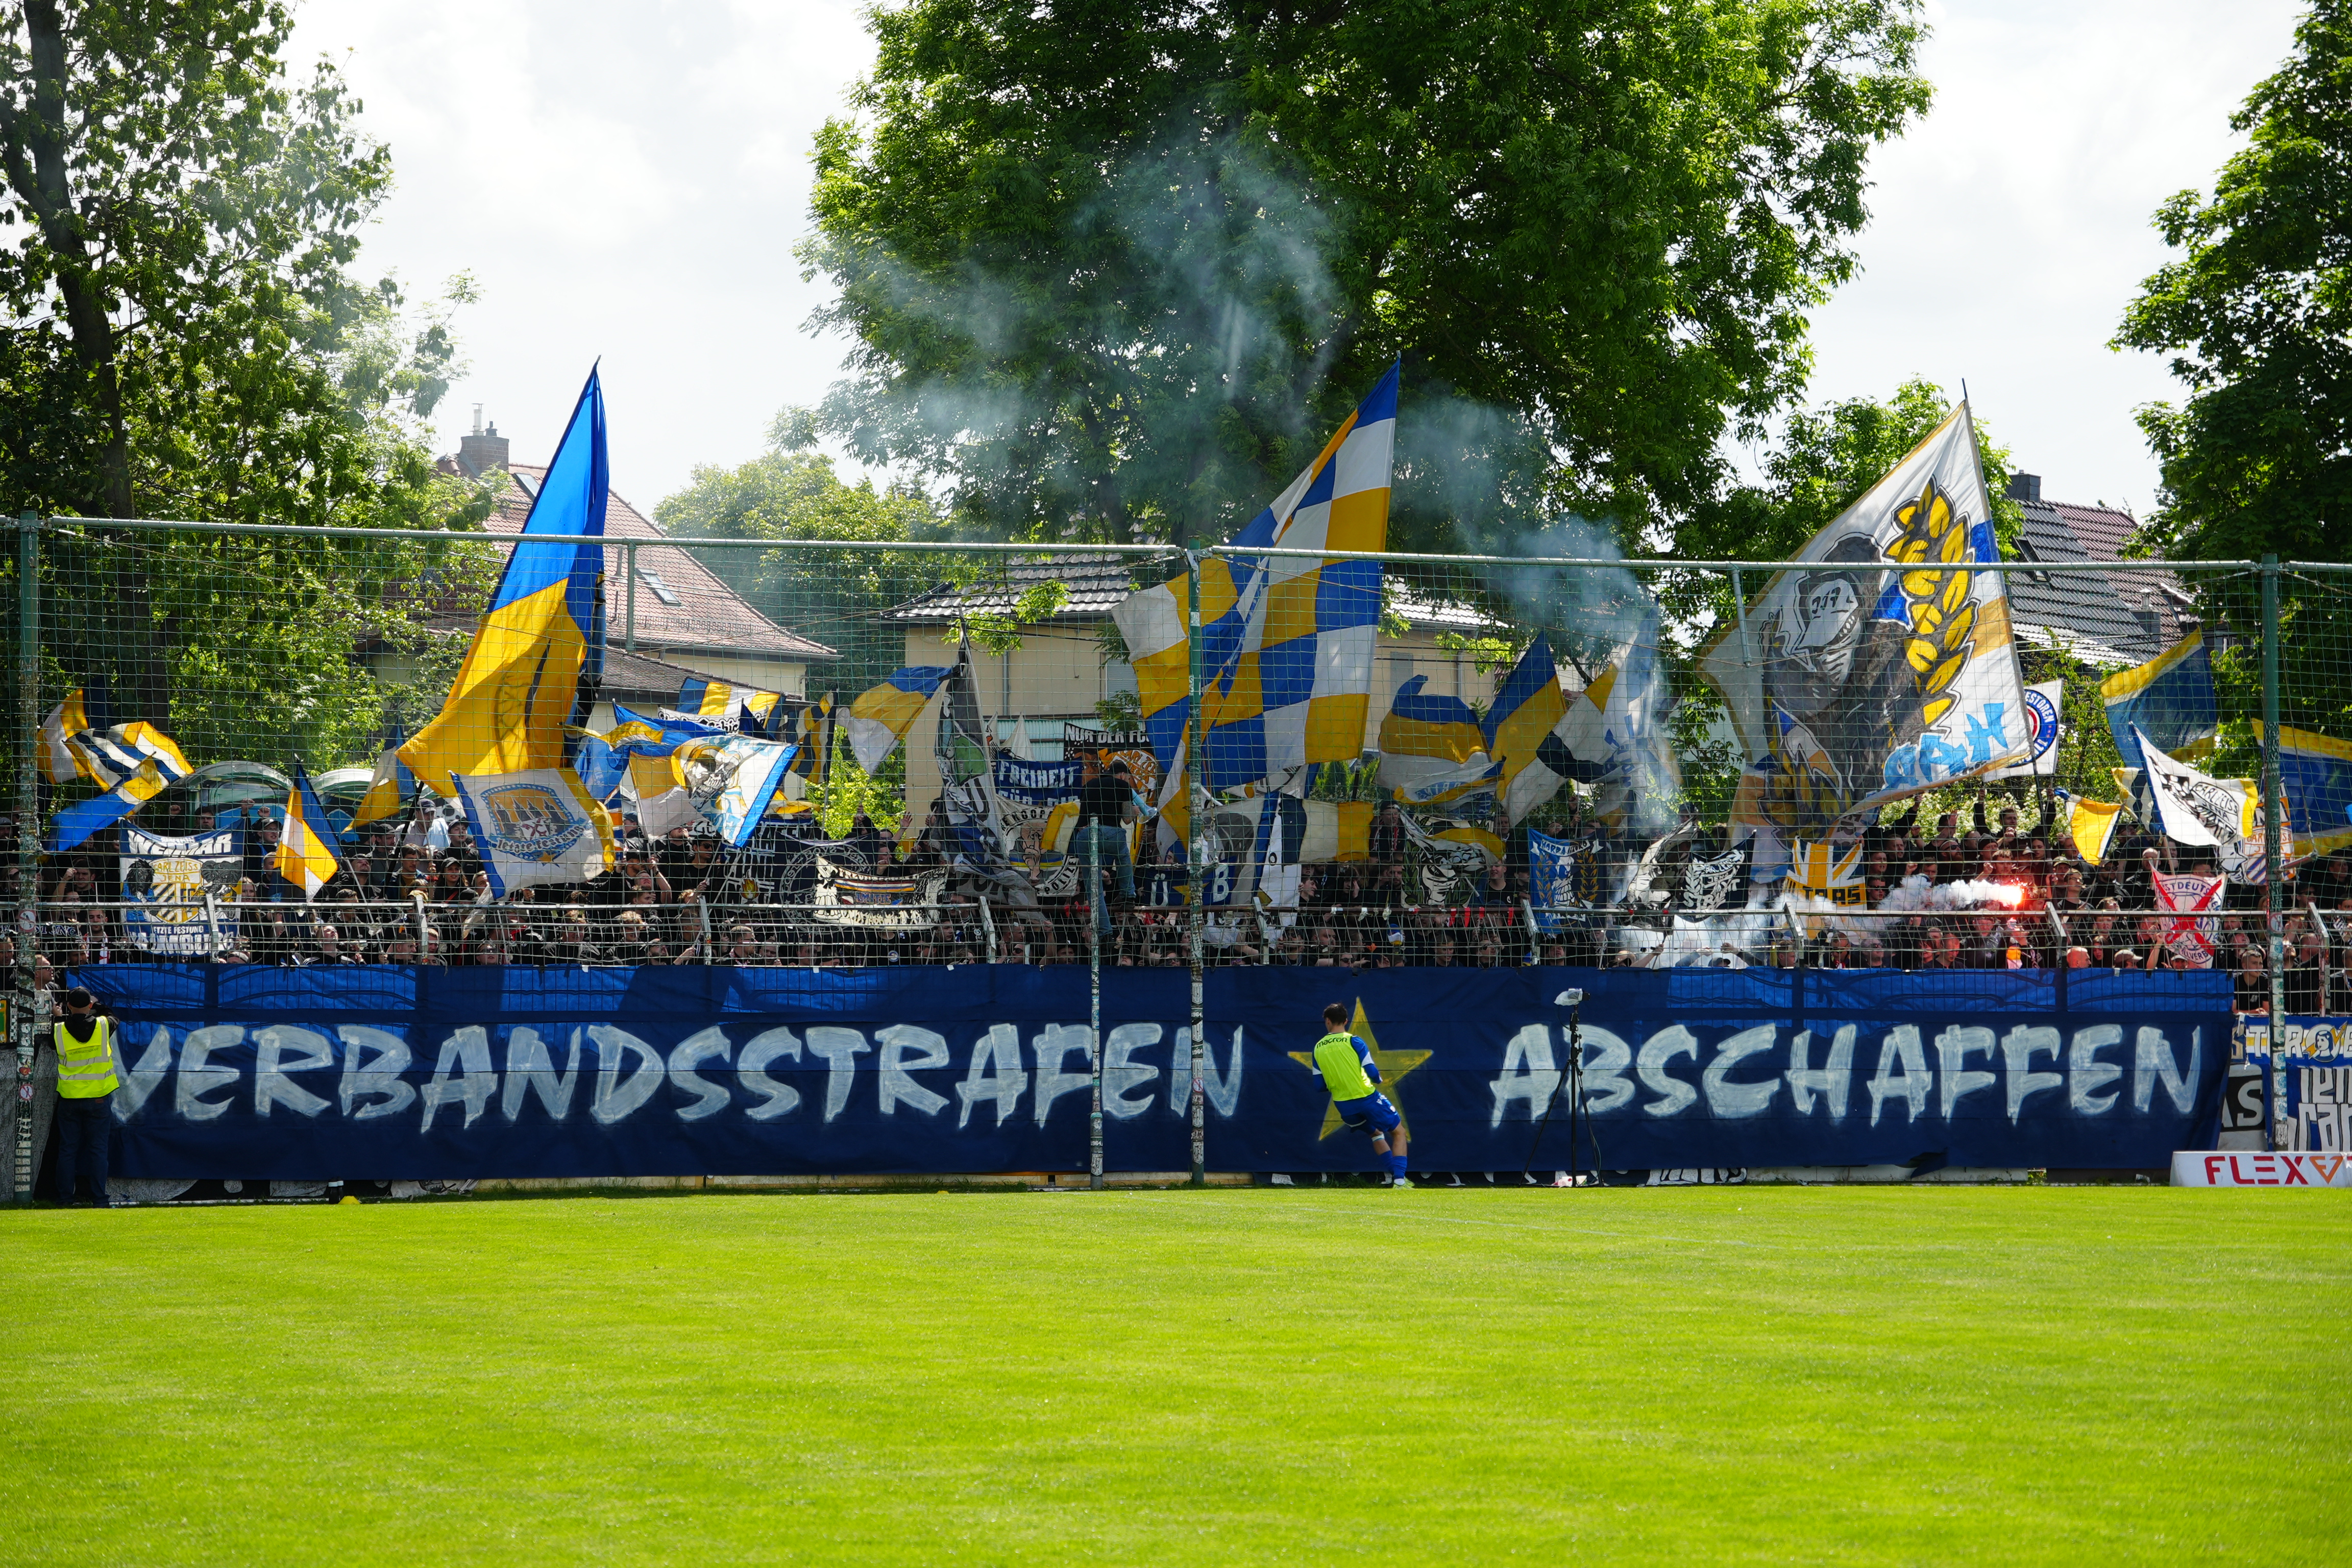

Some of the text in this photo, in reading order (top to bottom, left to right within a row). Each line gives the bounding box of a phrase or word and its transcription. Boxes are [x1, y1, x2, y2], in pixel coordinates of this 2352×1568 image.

[1065, 725, 1093, 742] NUR
[1098, 731, 1124, 744] DER
[998, 760, 1080, 789] FREIHEIT
[128, 830, 232, 857] WEIMAR
[154, 861, 198, 872] CARL ZEISS
[175, 925, 204, 934] FESTUNG
[1316, 1037, 1348, 1049] macron
[110, 1022, 1243, 1135] VERBANDSSTRAFEN
[1489, 1023, 2201, 1129] ABSCHAFFEN
